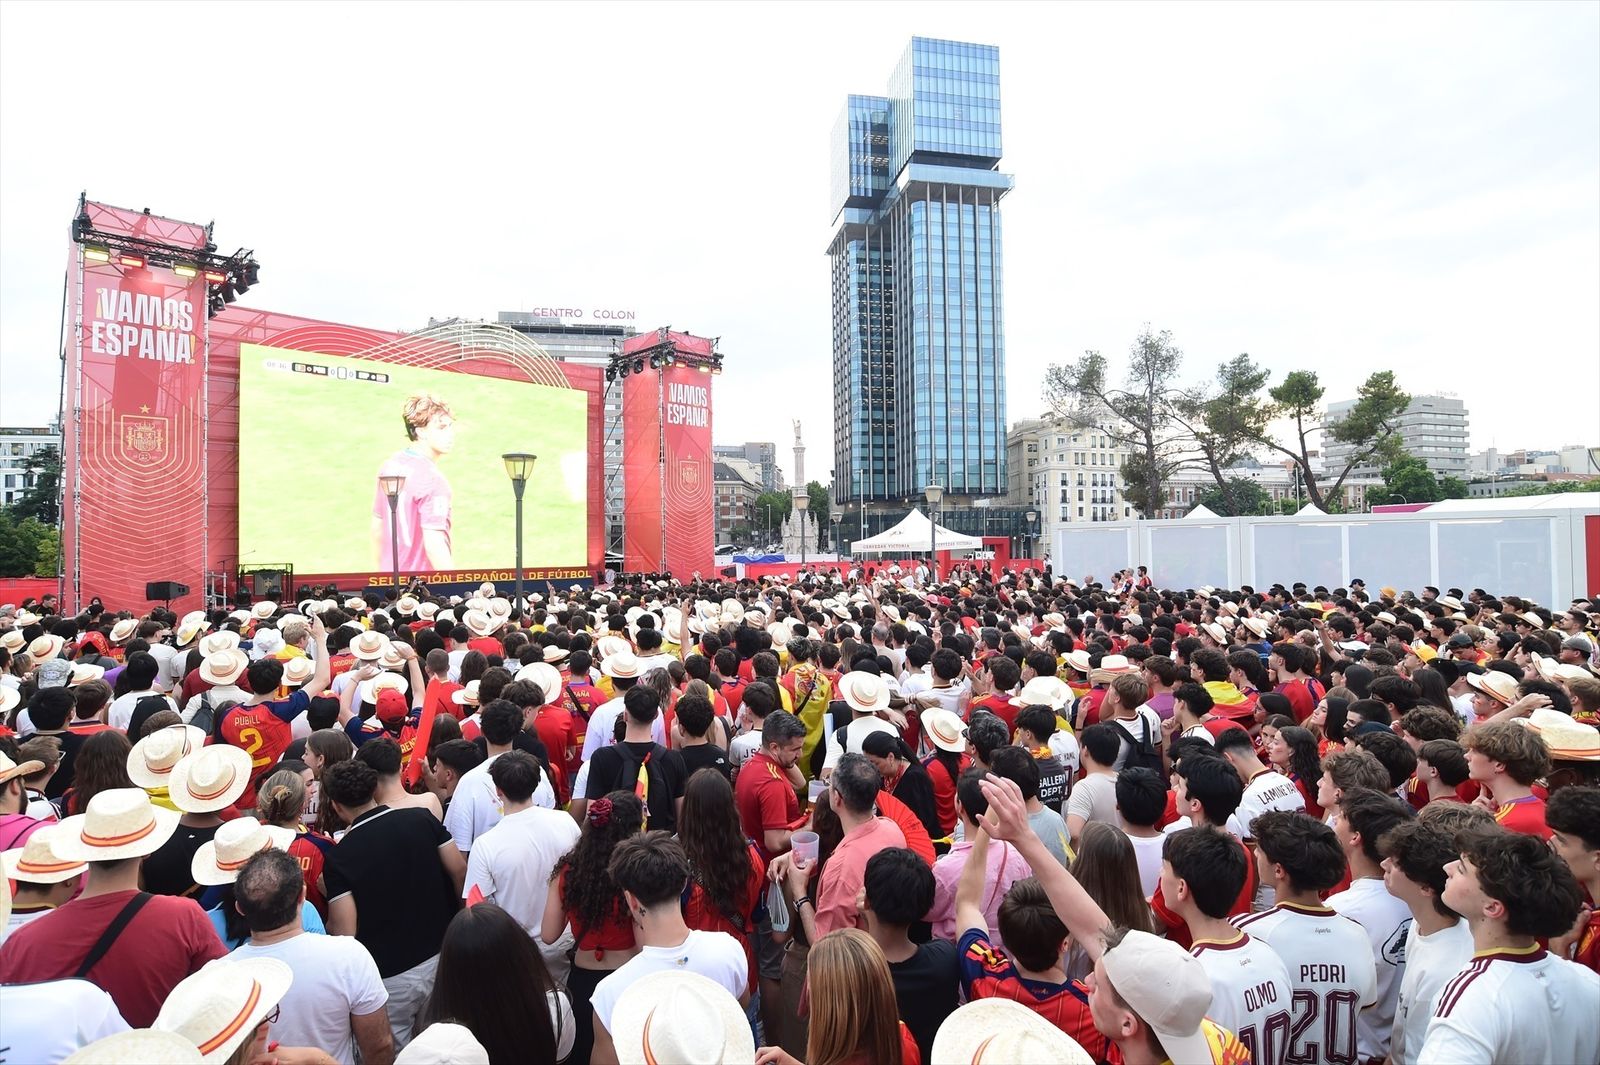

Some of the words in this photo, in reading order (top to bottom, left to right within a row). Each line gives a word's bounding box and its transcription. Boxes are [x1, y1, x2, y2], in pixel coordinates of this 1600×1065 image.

[533, 307, 583, 318] CENTRO
[593, 309, 635, 320] COLON
[369, 571, 452, 586] SELEIÓN
[456, 570, 525, 583] ESPAÑOL
[529, 571, 547, 580] DE
[548, 567, 592, 579] FÚTBOL
[234, 714, 261, 727] PUBILL
[239, 727, 272, 768] 2
[1257, 784, 1289, 805] LAMINE
[1299, 964, 1346, 983] PEDRI
[1243, 980, 1278, 1013] OLMO
[1286, 988, 1360, 1065] 20
